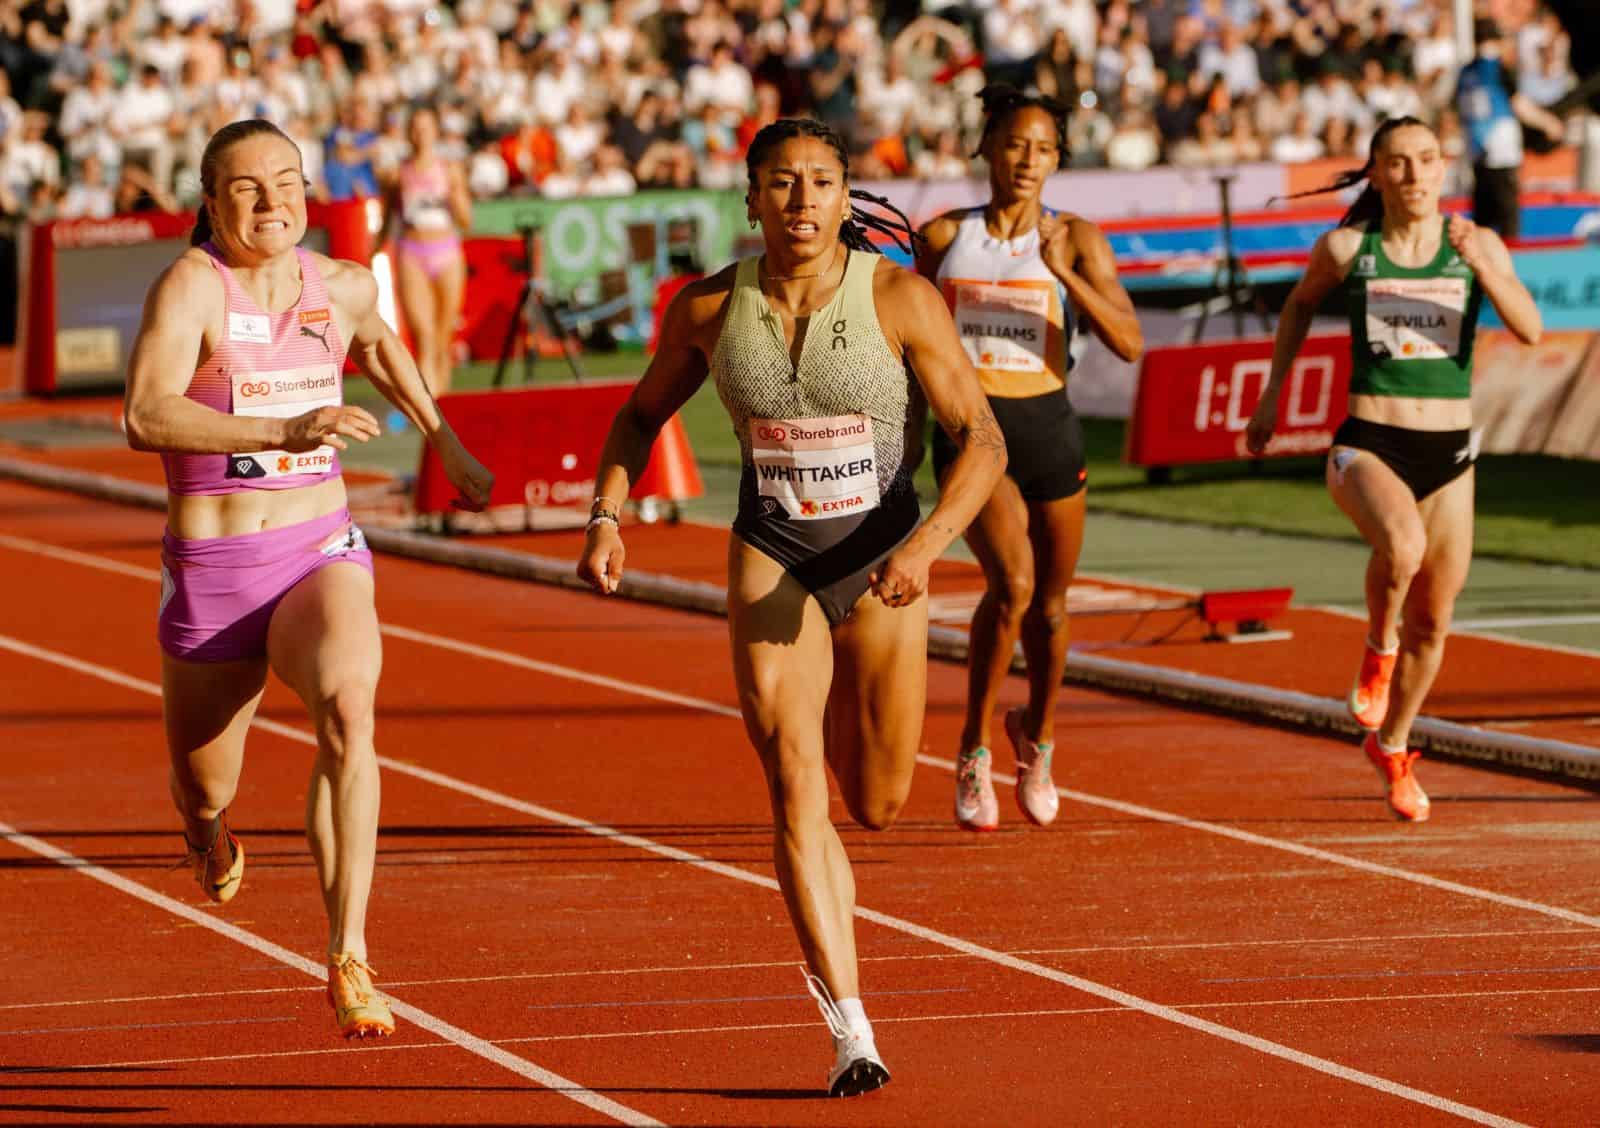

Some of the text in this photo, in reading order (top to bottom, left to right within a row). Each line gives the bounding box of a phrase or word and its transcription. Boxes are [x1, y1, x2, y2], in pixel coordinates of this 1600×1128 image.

[1382, 314, 1447, 329] SEVILLA
[961, 322, 1037, 342] WILLIAMS
[273, 371, 336, 393] Storebrand
[789, 422, 866, 441] Storebrand
[296, 455, 333, 467] EXTRA
[758, 457, 874, 483] WHITTAKER
[821, 495, 864, 512] EXTRA
